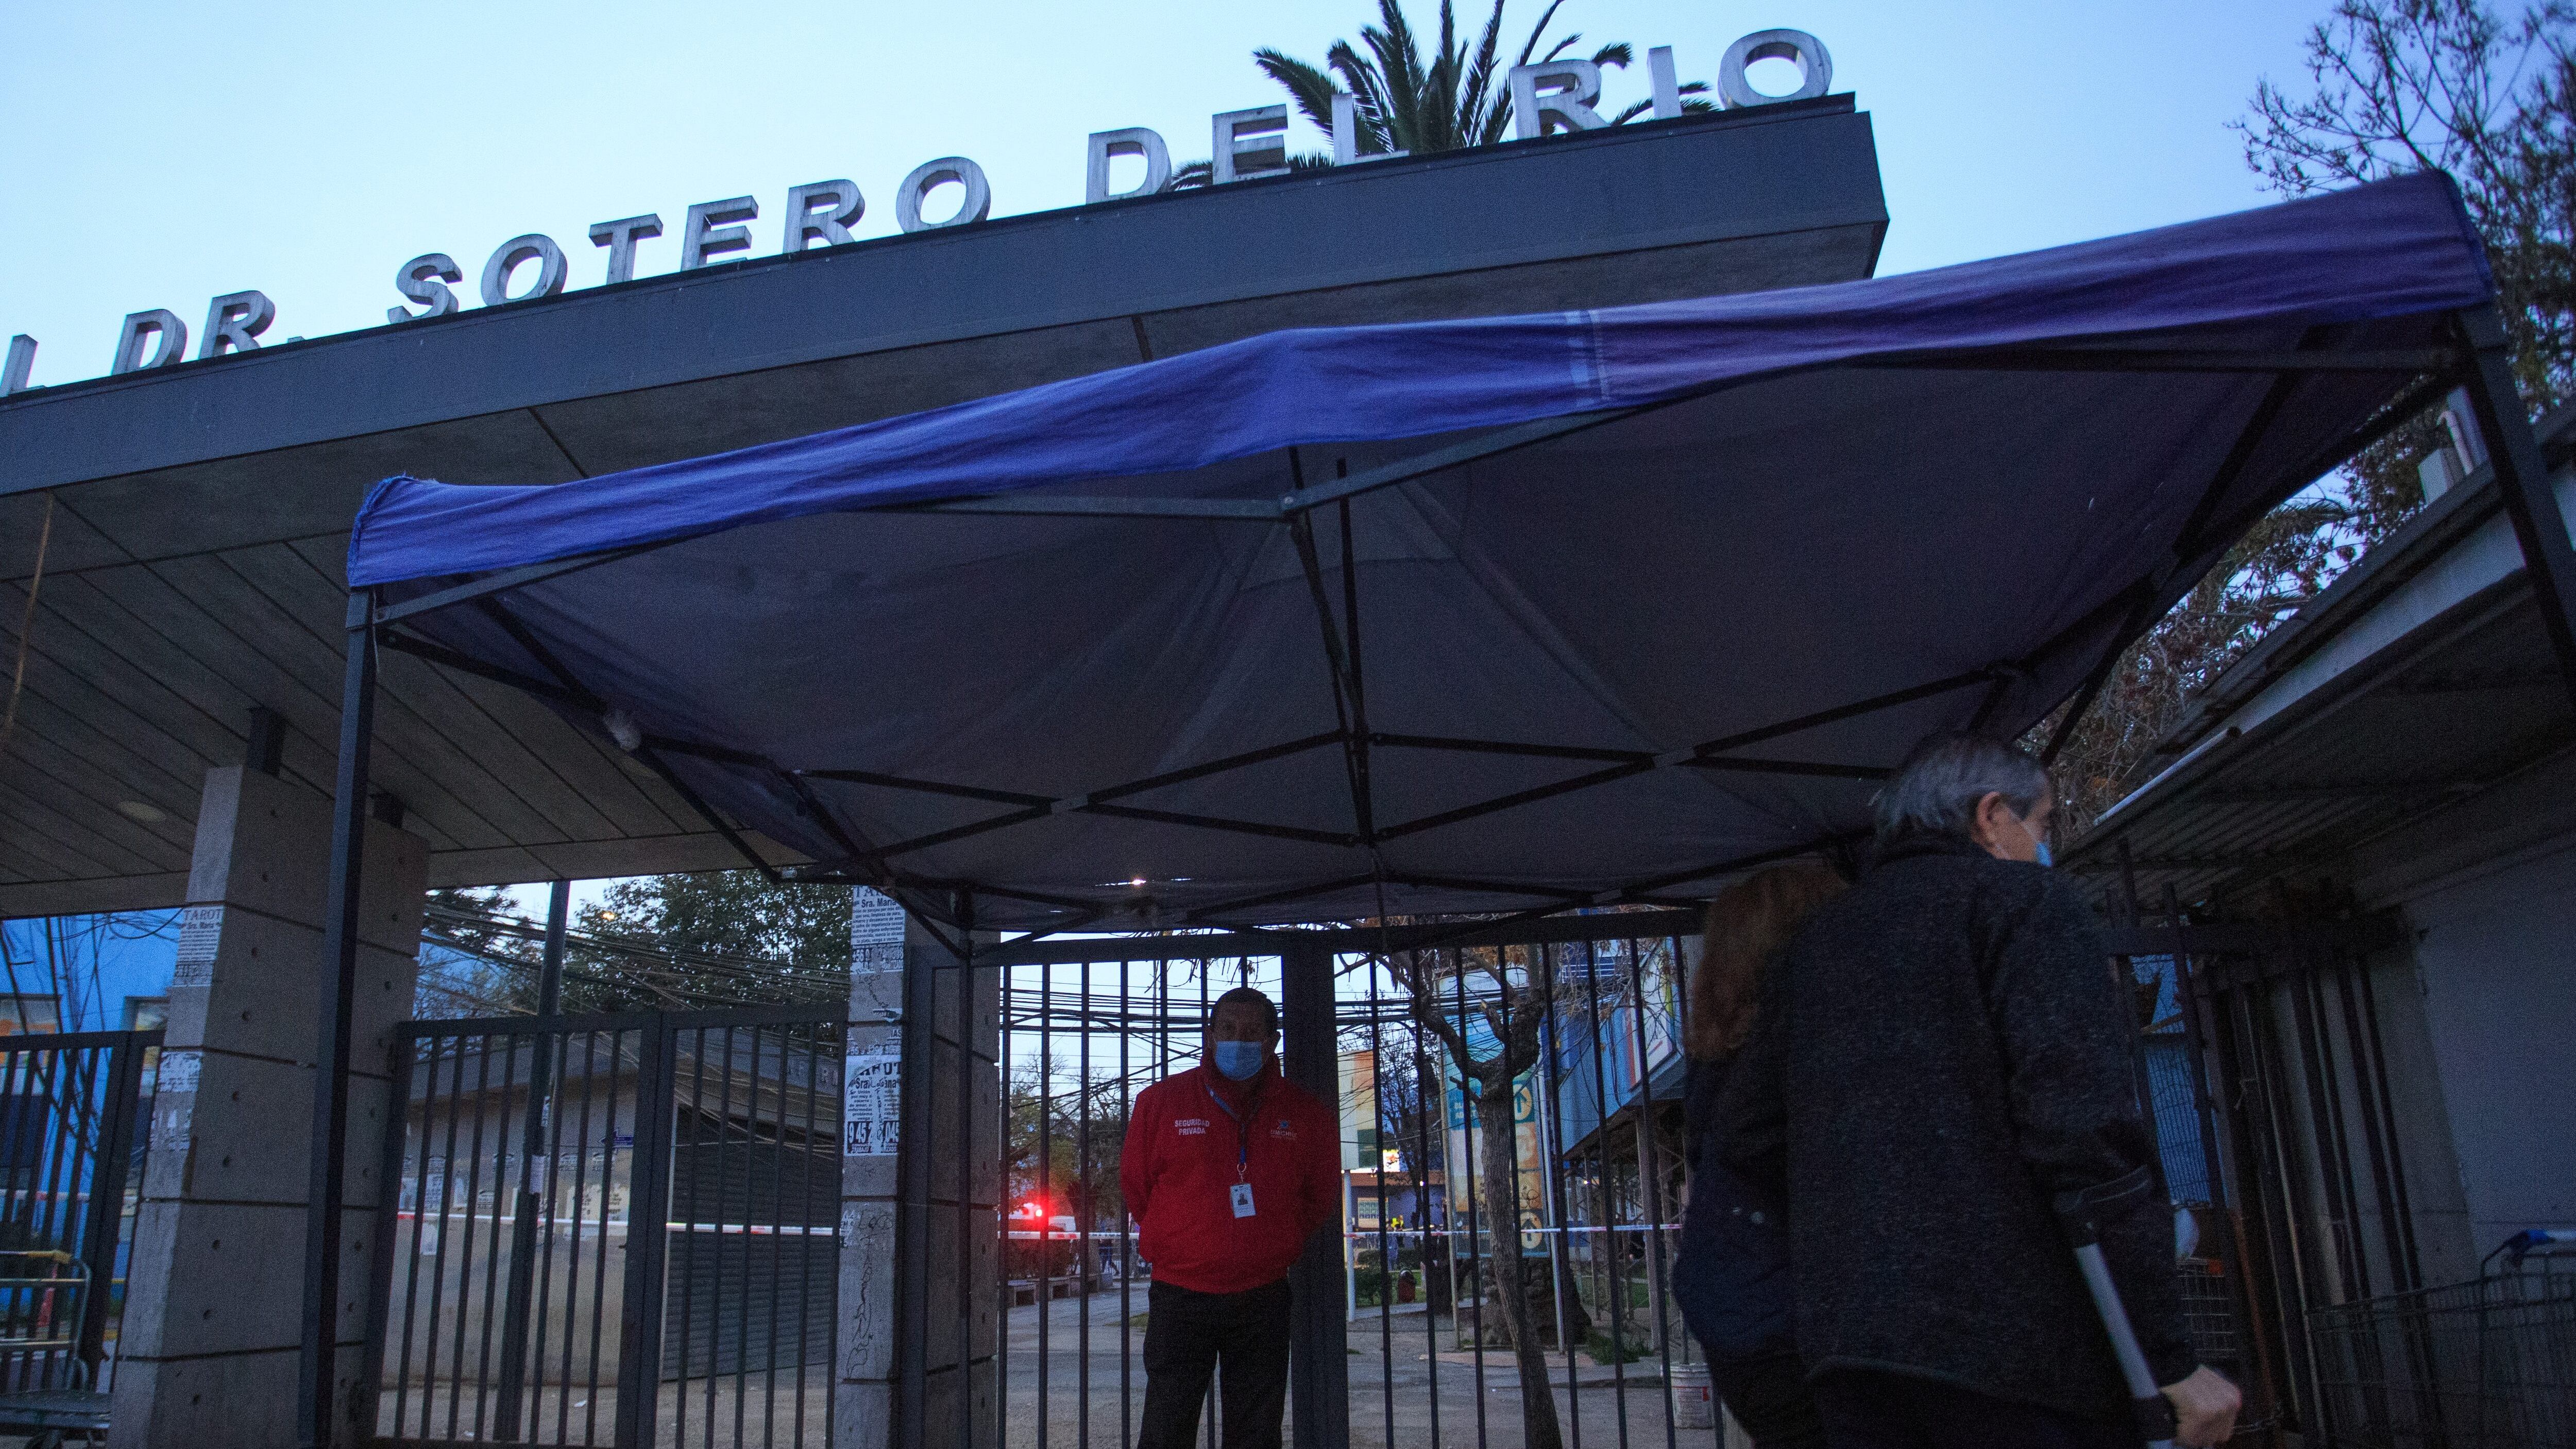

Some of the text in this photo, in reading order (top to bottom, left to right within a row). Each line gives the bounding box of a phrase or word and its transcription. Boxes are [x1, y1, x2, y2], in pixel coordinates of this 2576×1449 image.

[388, 156, 991, 324] SOTERO
[1086, 93, 1410, 205] DEL
[1510, 28, 1832, 140] RIO
[184, 909, 221, 921] TAROT
[1175, 1118, 1210, 1127] SEGURIDAD
[1179, 1127, 1206, 1136] PRIVADA
